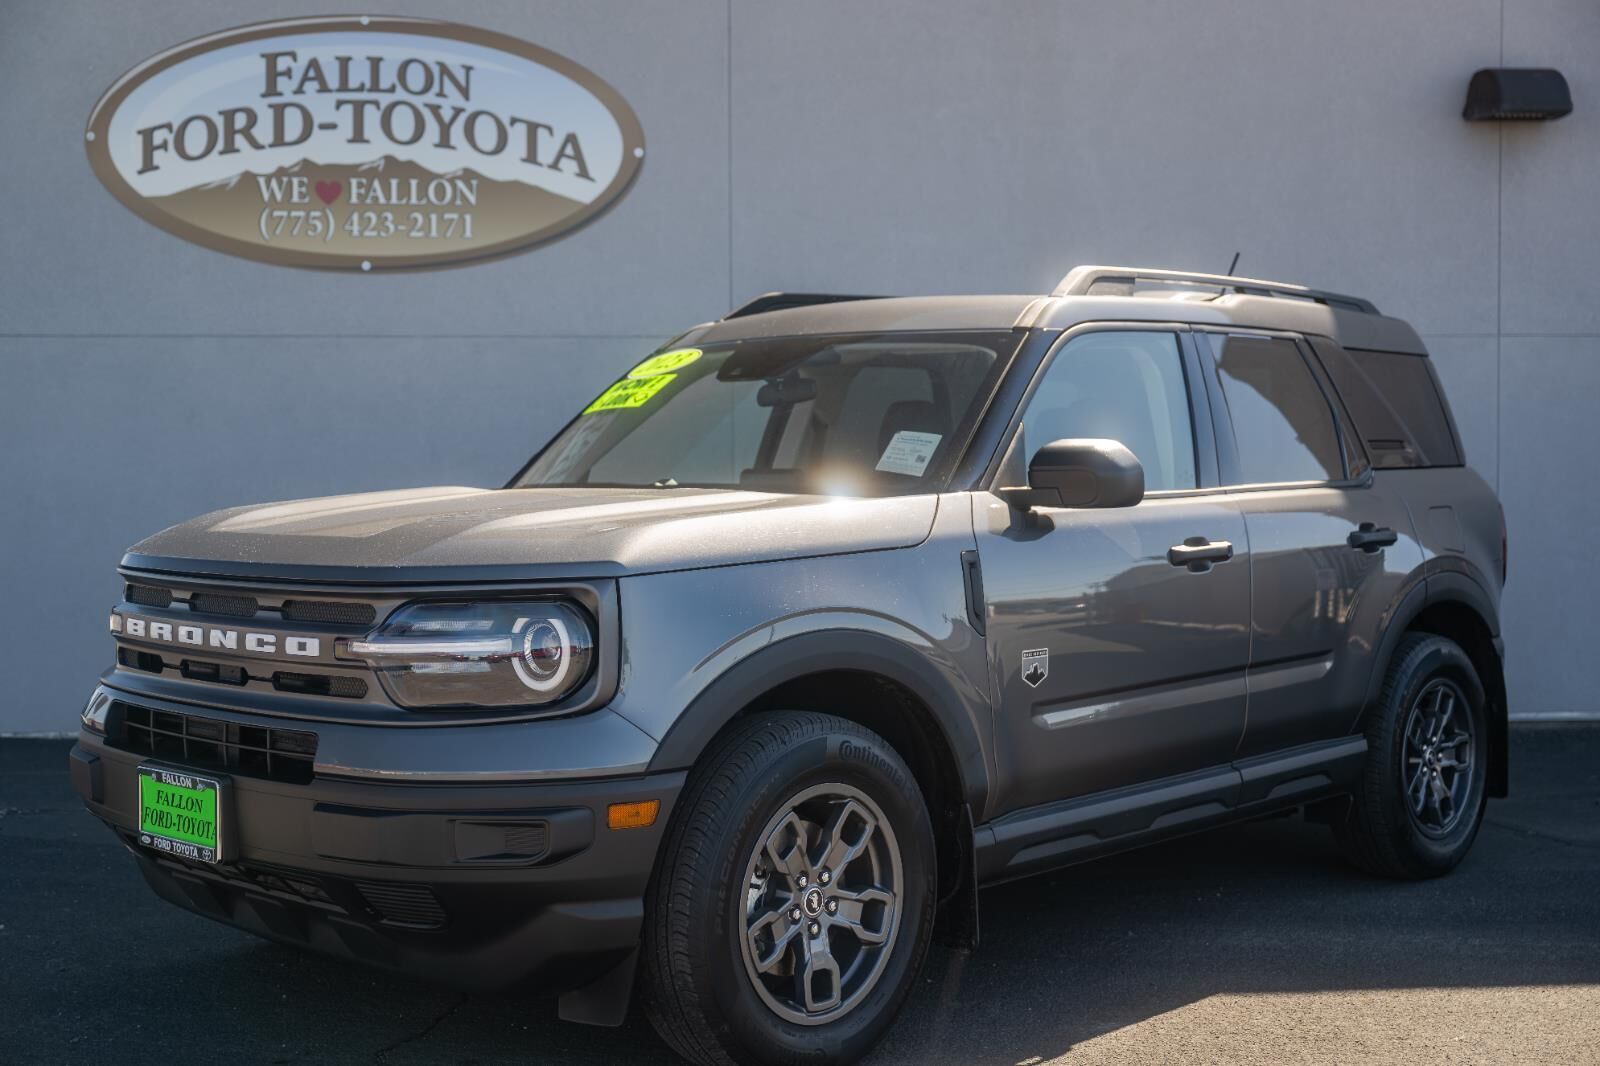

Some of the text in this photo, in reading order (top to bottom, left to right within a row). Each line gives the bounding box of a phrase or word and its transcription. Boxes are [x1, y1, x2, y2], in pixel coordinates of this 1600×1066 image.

[260, 51, 475, 101] FALLON
[136, 100, 596, 184] FORD-TOYOTA
[257, 176, 478, 206] WE FALLON
[259, 208, 474, 243] (775) 423-2171
[126, 618, 320, 657] BRONCO
[161, 773, 192, 788] FALLON
[156, 789, 203, 814] FALLON
[153, 837, 199, 858] FORD TOYOTA
